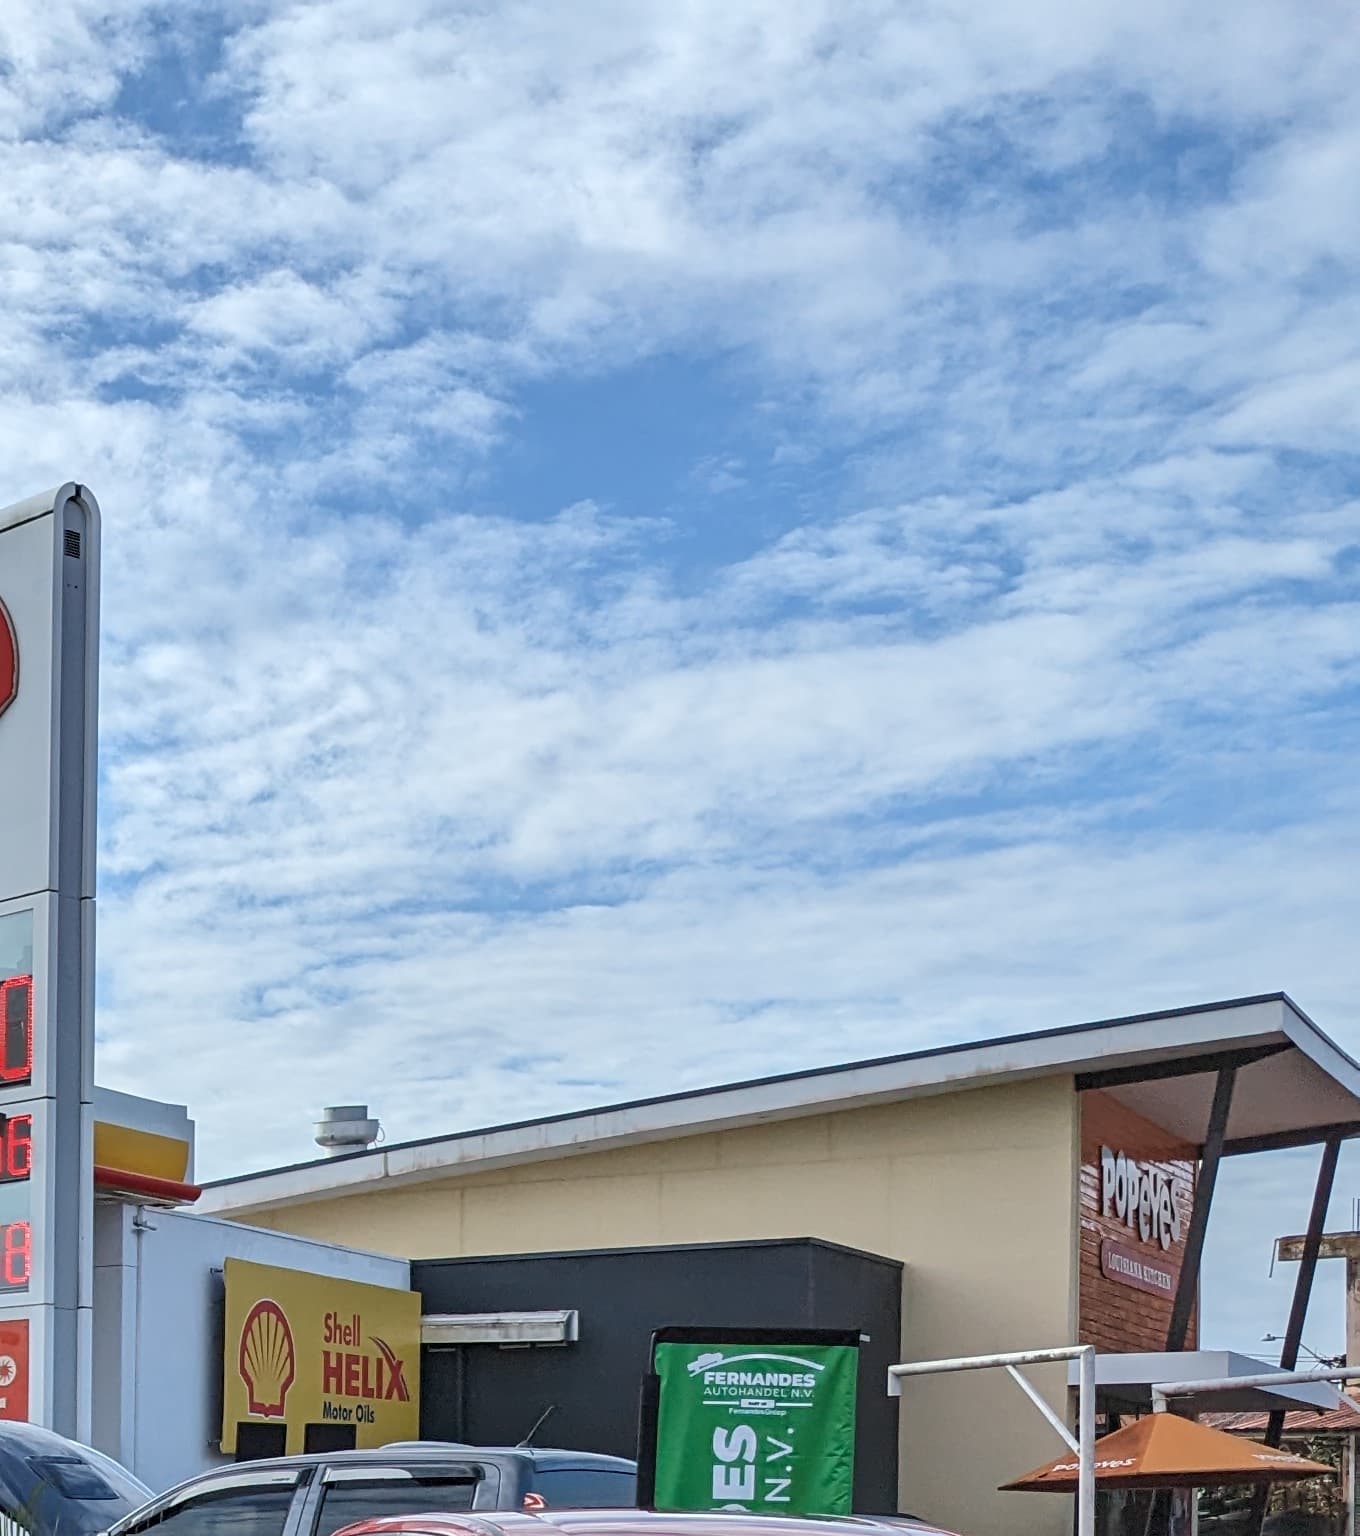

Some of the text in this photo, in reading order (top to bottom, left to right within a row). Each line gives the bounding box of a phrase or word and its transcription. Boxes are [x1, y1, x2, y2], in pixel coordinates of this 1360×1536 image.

[323, 1311, 360, 1347] Shell
[322, 1339, 409, 1402] HELIX
[704, 1371, 816, 1387] FERNANDES
[703, 1386, 815, 1398] AUTOHANDEL N.V.
[322, 1401, 375, 1423] Motor Oils
